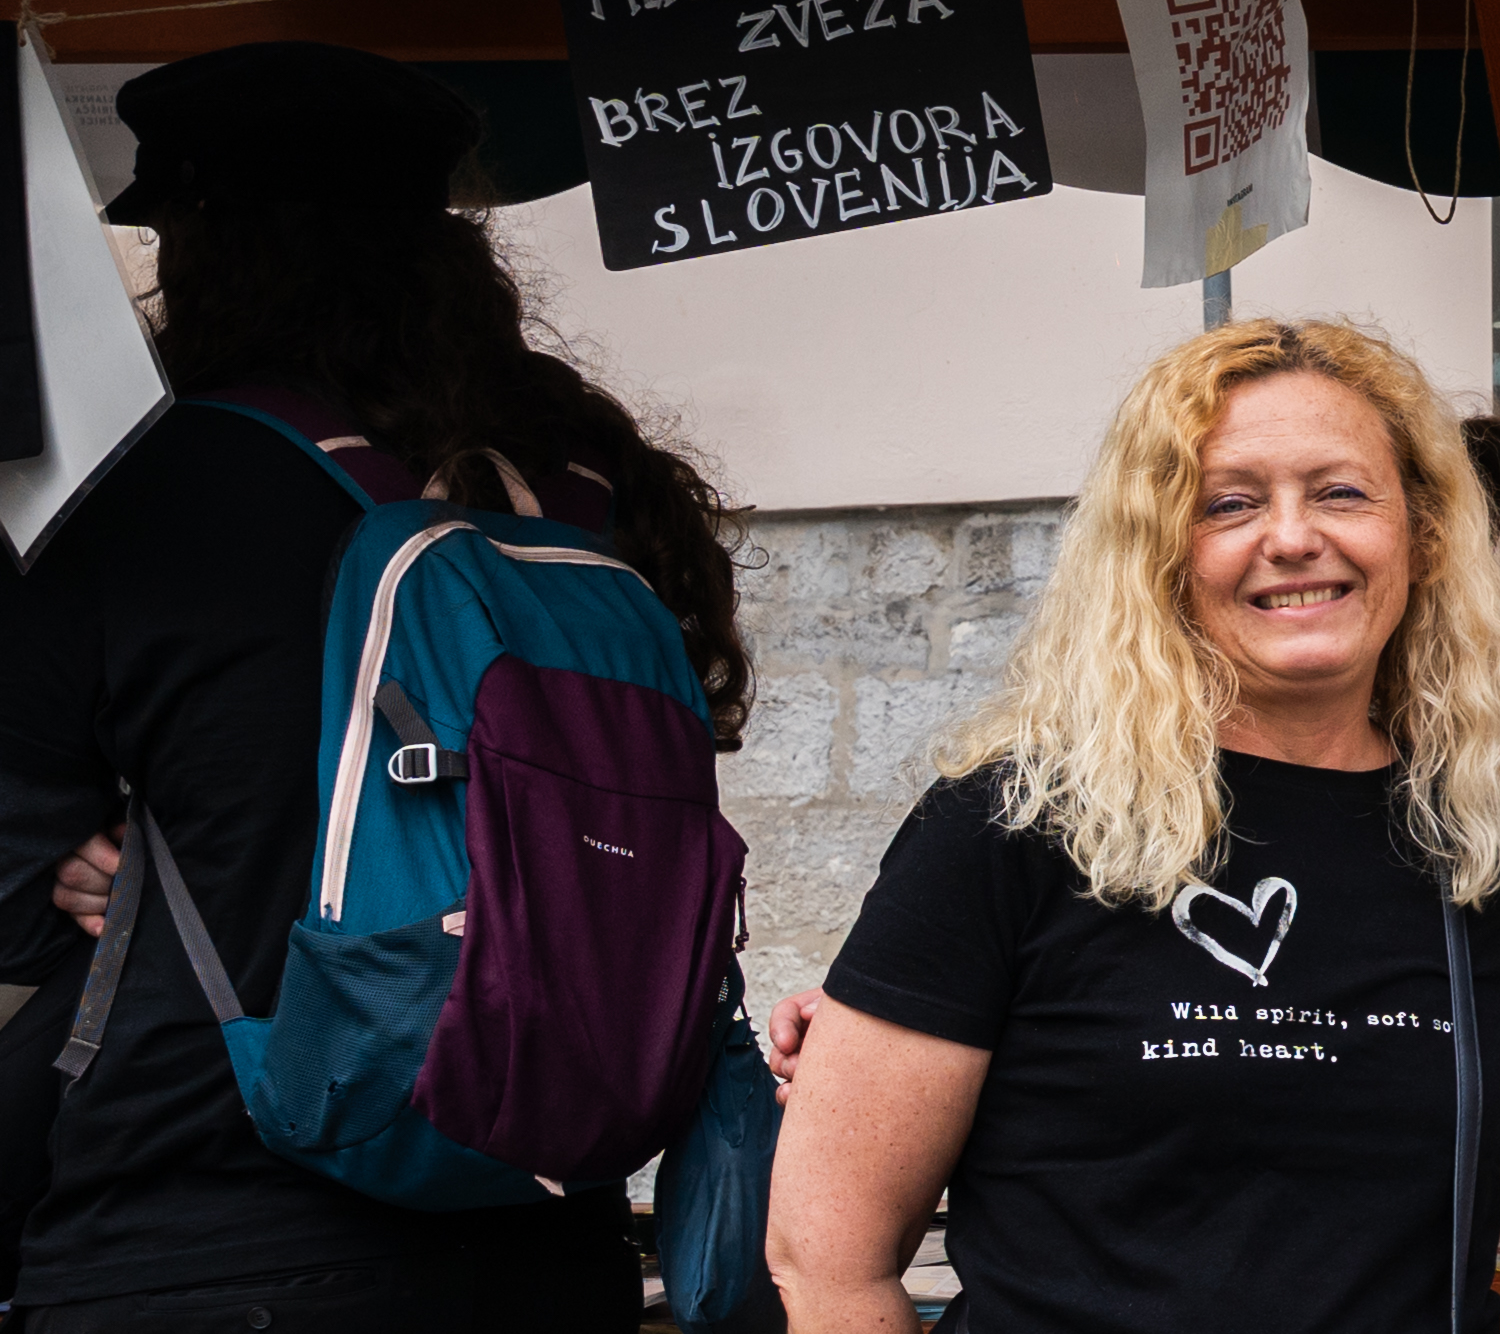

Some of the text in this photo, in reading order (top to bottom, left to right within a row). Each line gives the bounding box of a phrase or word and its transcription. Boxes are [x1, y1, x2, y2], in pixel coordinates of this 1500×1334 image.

[590, 75, 761, 148] BREZ
[711, 92, 1025, 192] IZGOVORA
[650, 149, 1040, 255] SLOVENIJA
[1142, 1038, 1338, 1063] kind heart.
[1171, 1002, 1454, 1033] Wild spirit, soft so
